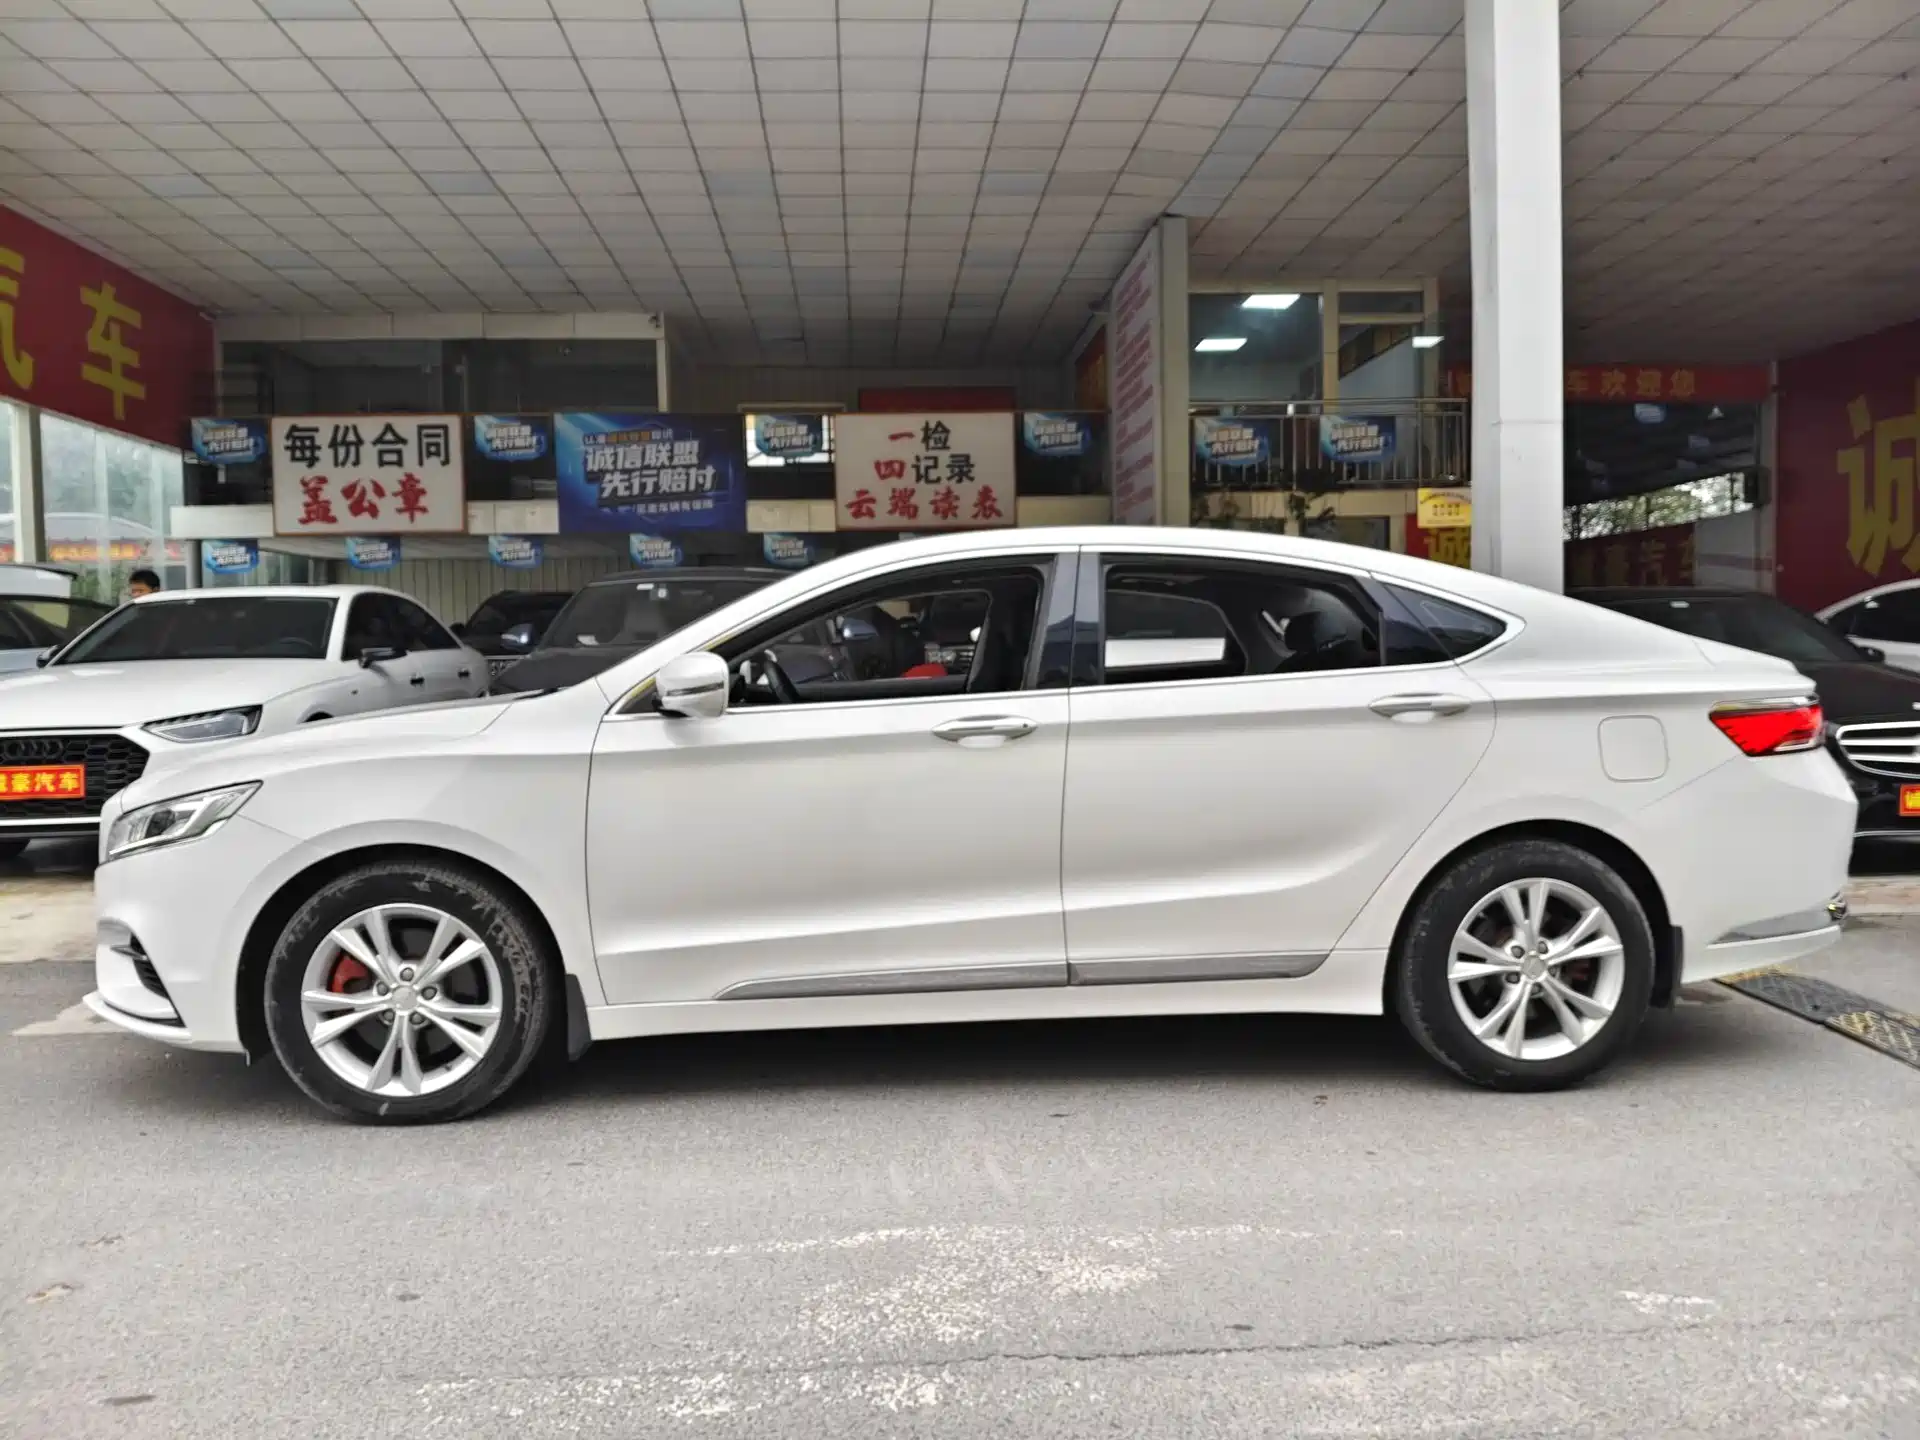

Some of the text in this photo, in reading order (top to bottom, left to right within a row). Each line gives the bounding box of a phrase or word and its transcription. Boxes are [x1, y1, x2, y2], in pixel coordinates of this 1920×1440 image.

[284, 423, 451, 470] 每份合同
[887, 420, 952, 452] 一检
[585, 439, 700, 472] 诚信联盟
[874, 453, 976, 485] 四记录
[600, 464, 717, 499] 先行赔付
[296, 472, 430, 526] 盖公章
